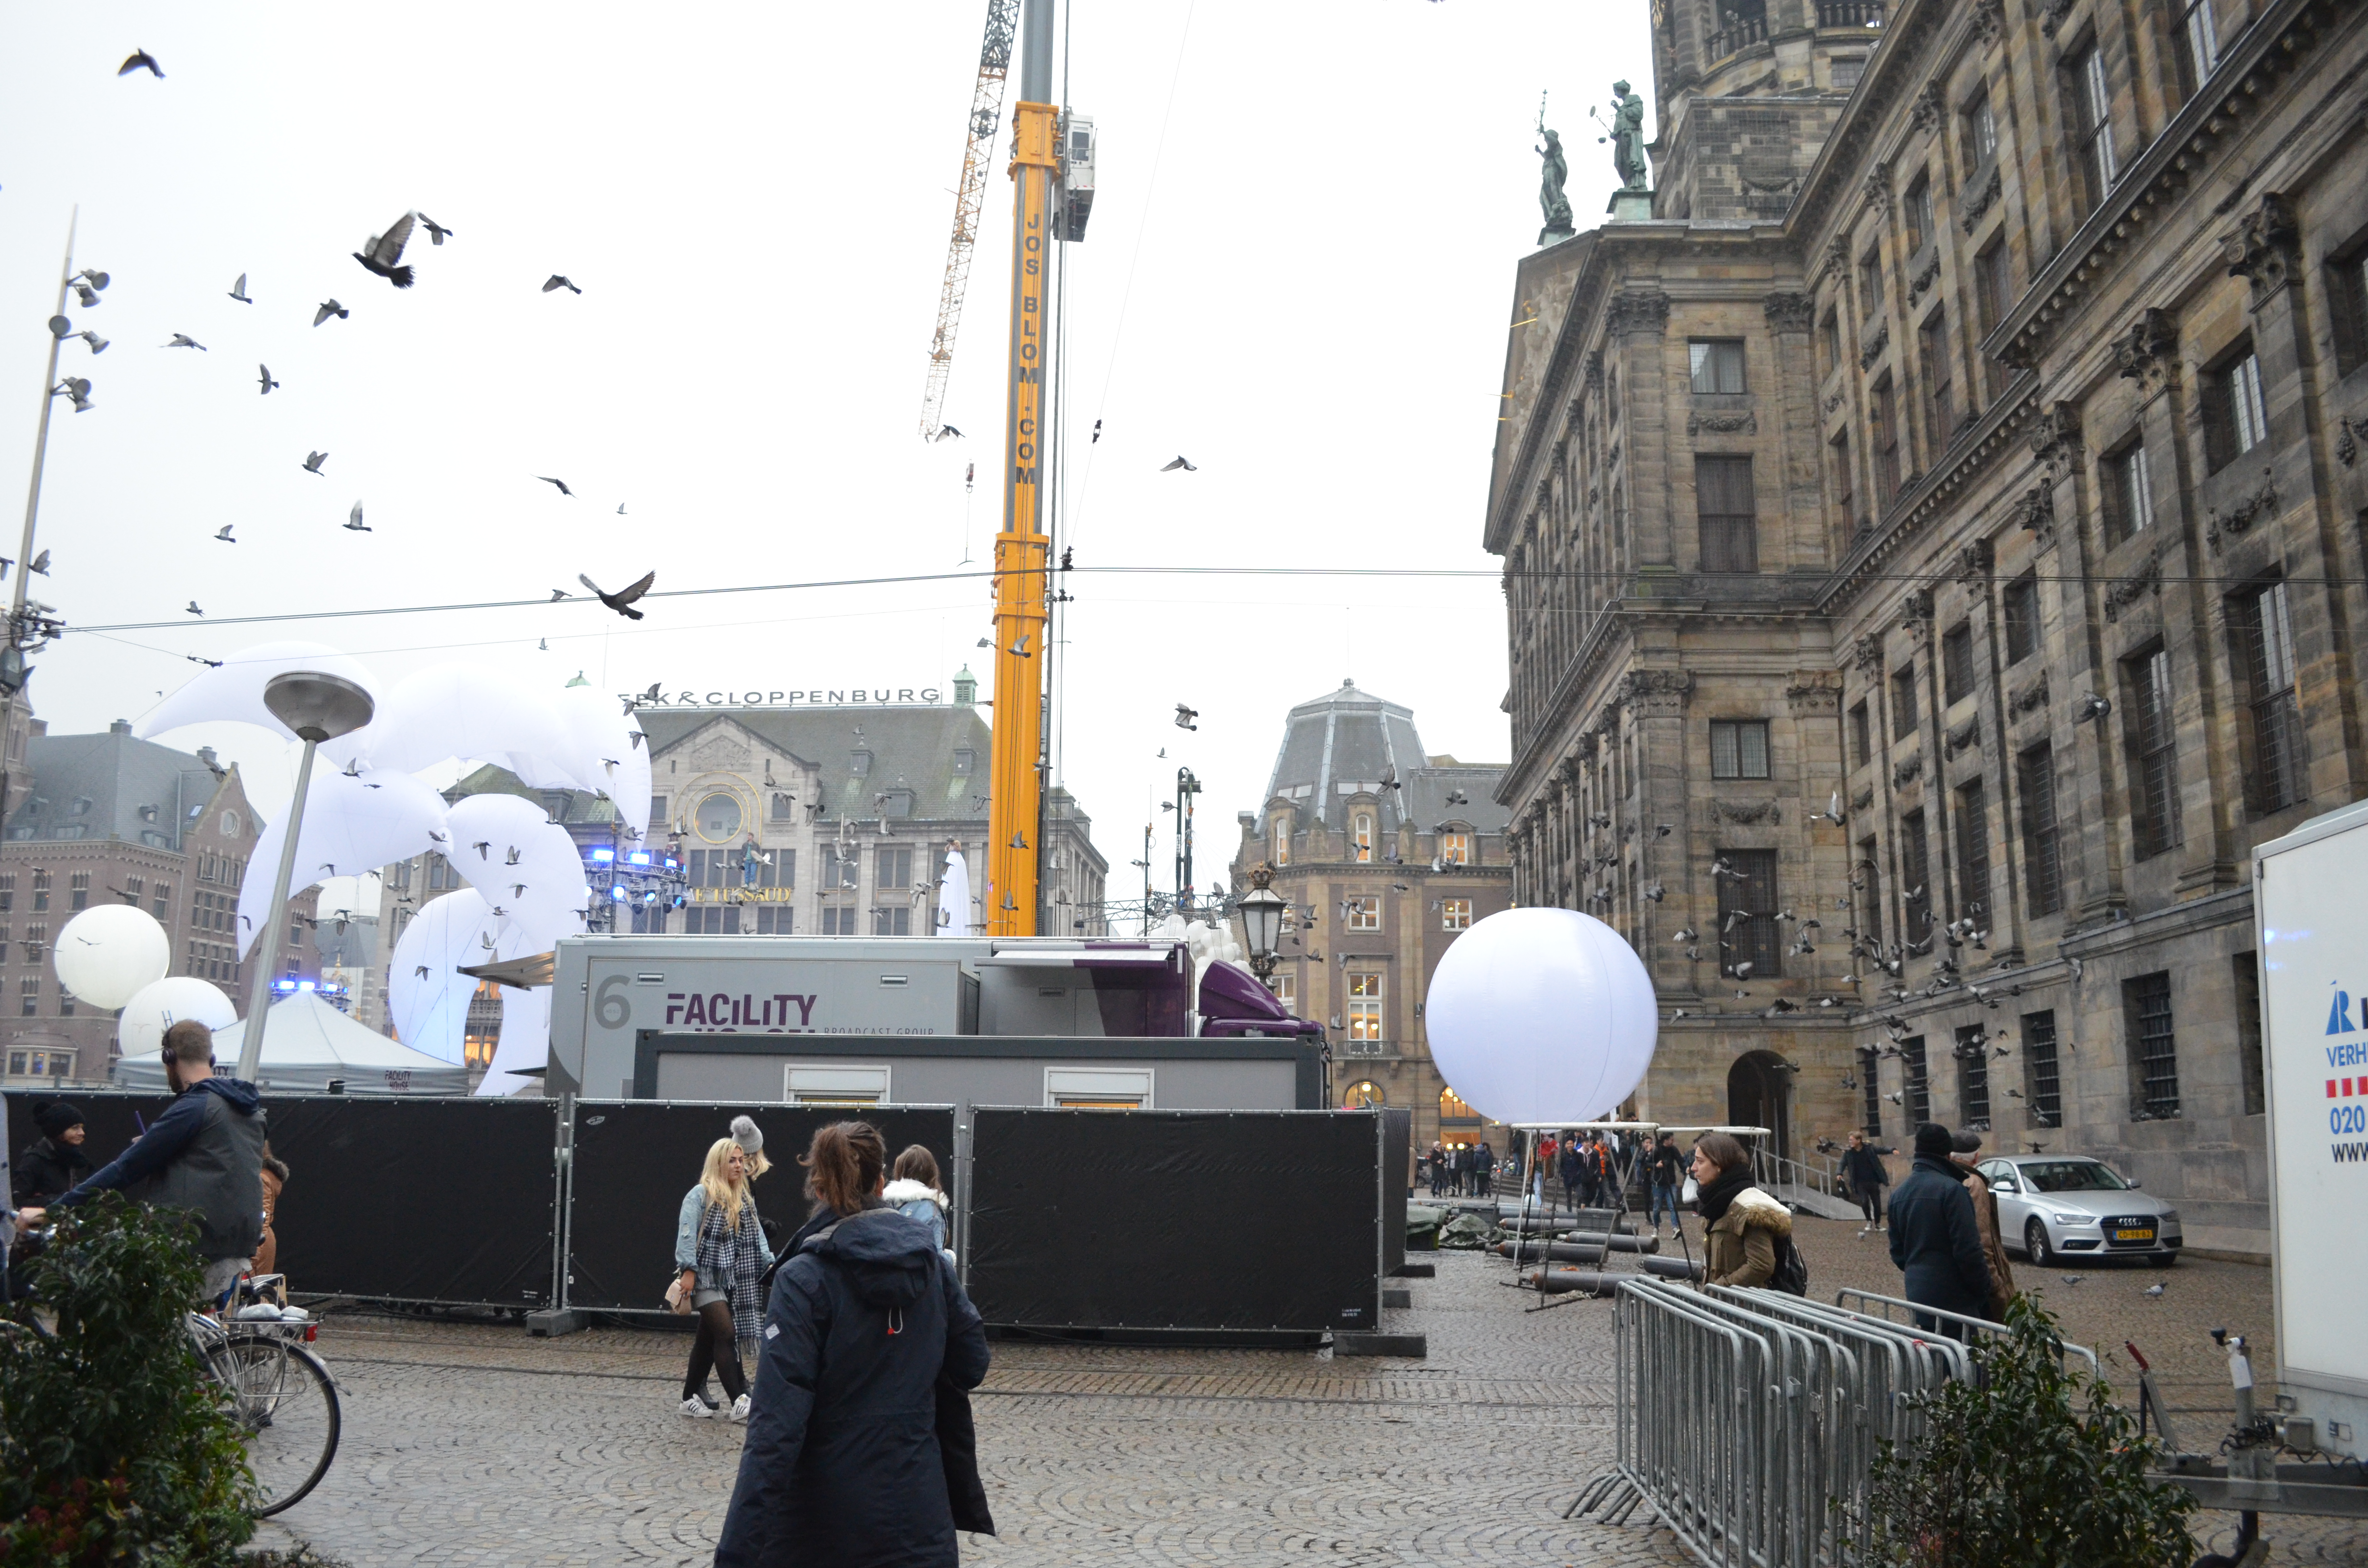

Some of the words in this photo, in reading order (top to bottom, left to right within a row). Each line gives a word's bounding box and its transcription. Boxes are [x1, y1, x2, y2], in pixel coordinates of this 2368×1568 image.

[1024, 213, 1041, 276] JOS
[1019, 295, 1038, 384] BLOM
[678, 691, 700, 705] &
[706, 688, 940, 704] CLOPPENBURG
[594, 975, 631, 1029] 6
[666, 993, 817, 1026] FACILITY
[2326, 1042, 2368, 1067] VERH
[385, 1070, 412, 1080] FACILITY
[2330, 1105, 2365, 1135] 020
